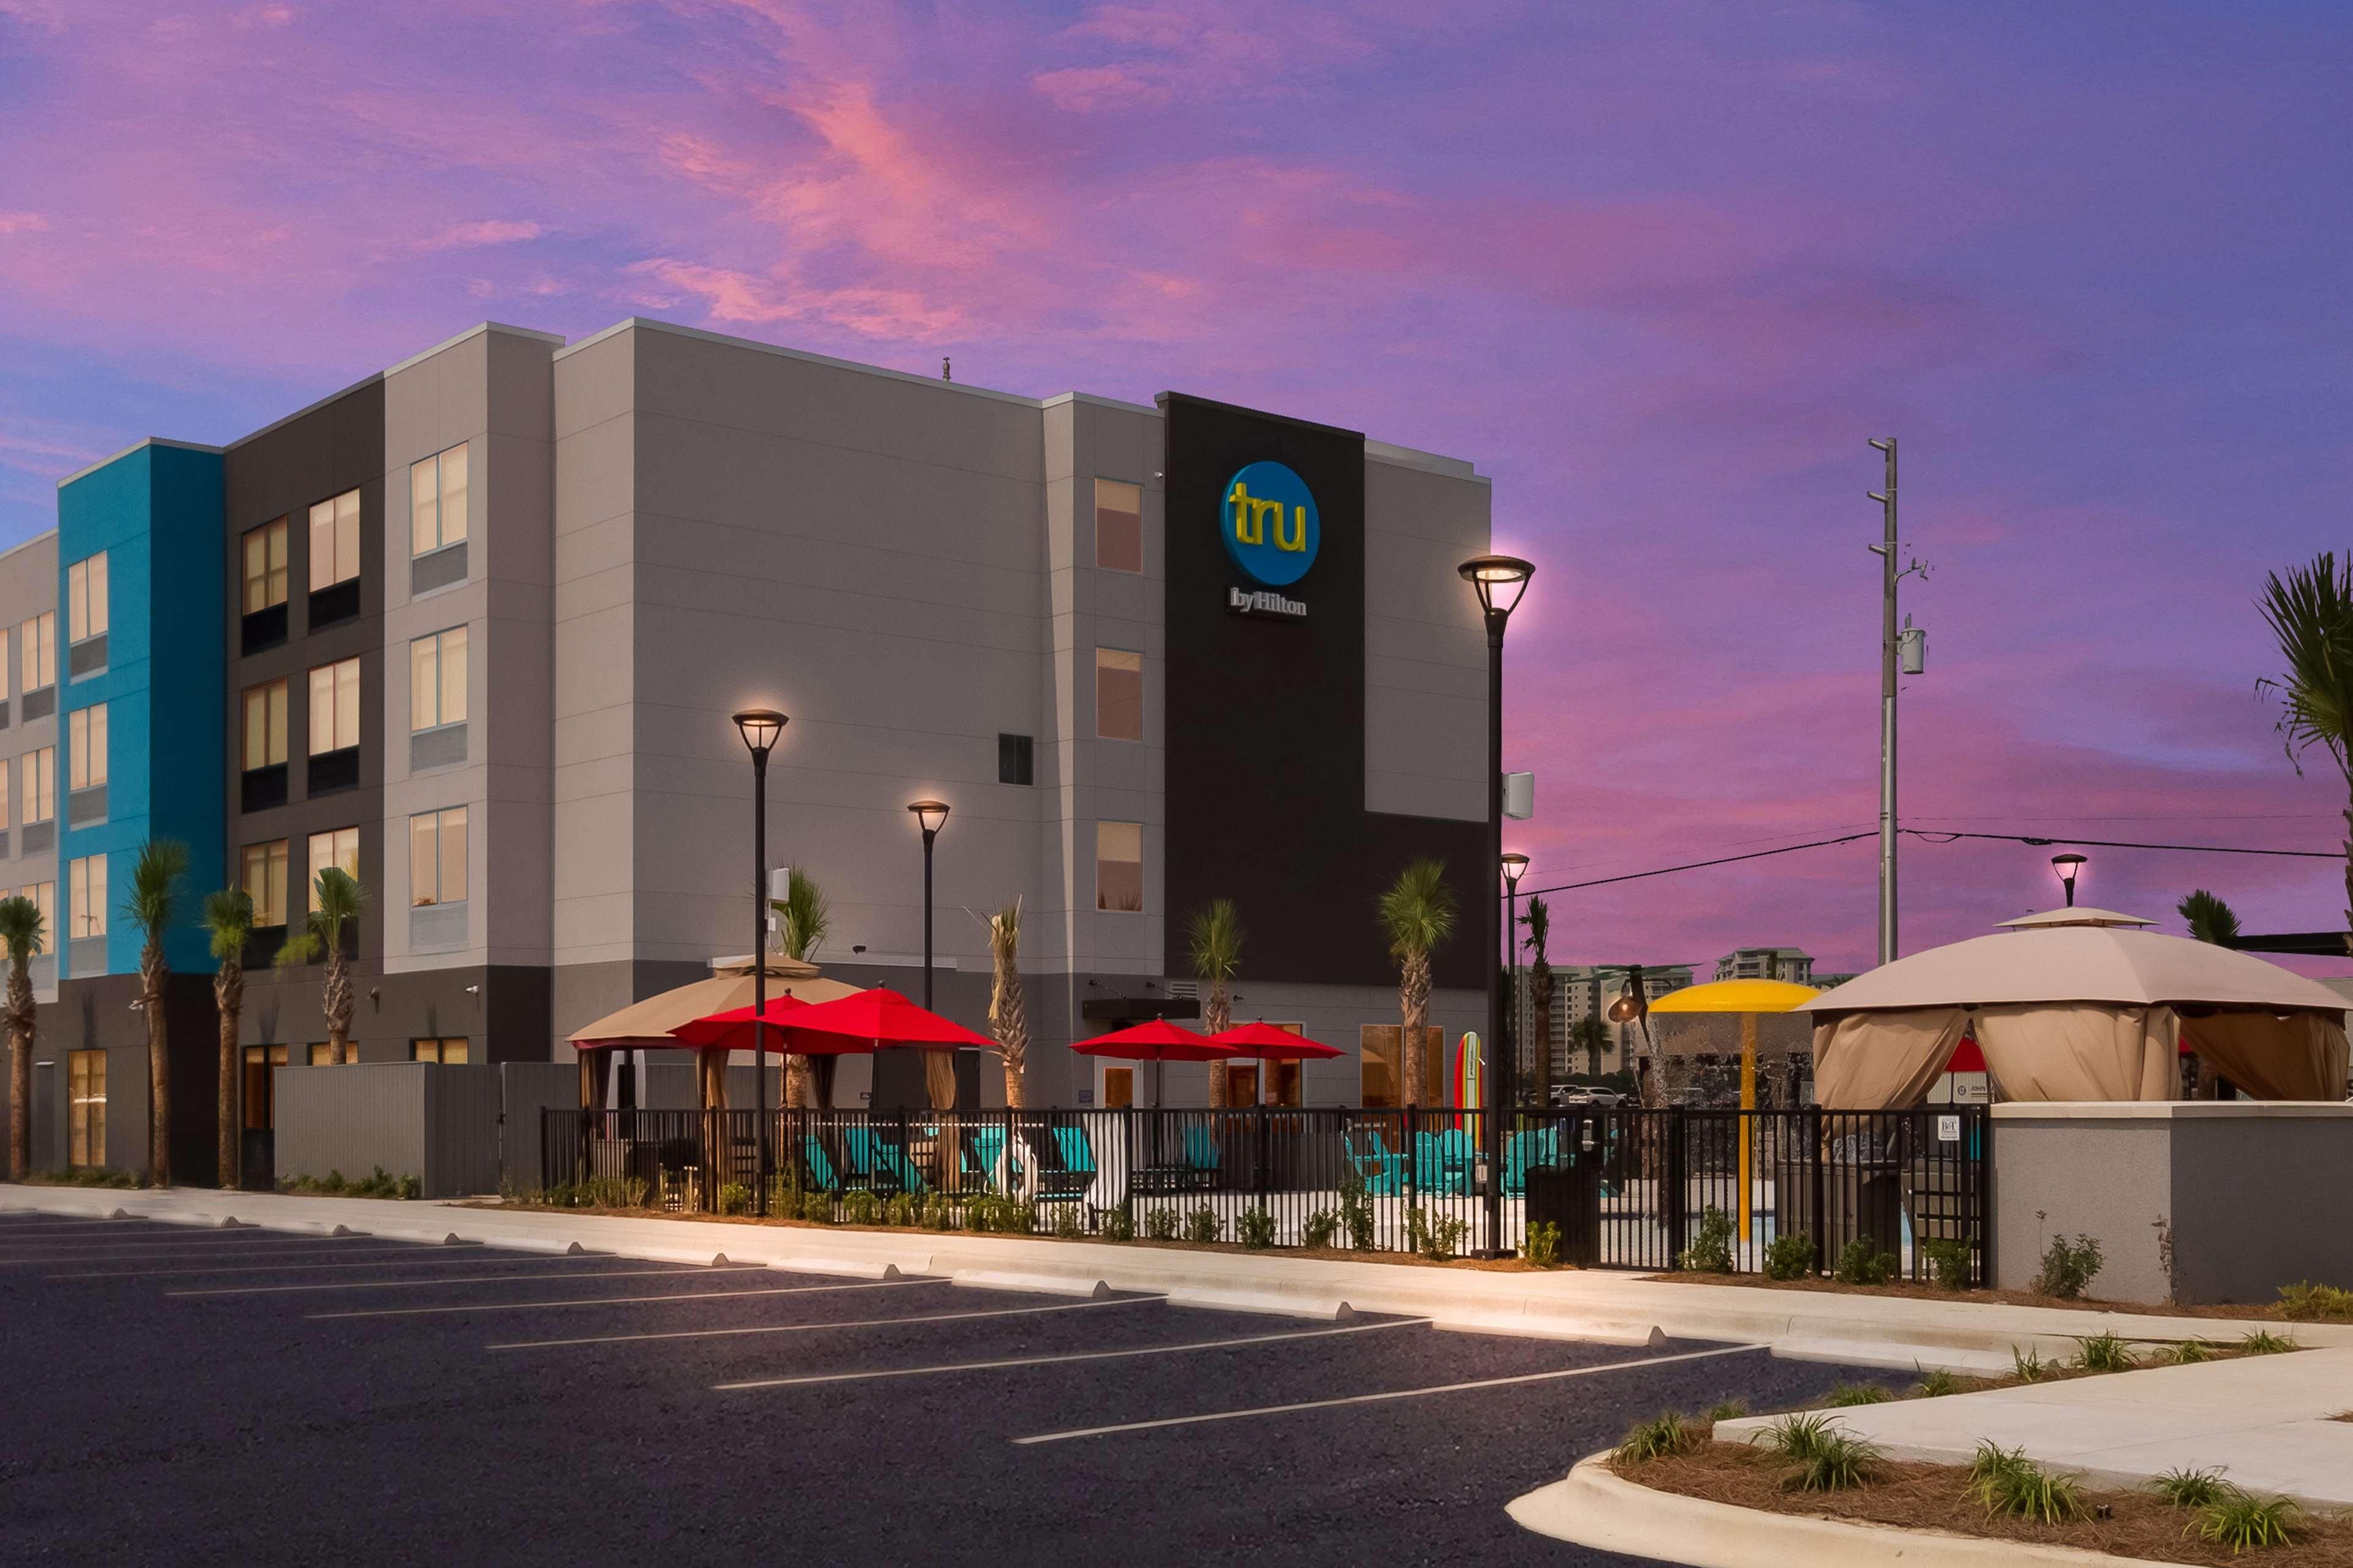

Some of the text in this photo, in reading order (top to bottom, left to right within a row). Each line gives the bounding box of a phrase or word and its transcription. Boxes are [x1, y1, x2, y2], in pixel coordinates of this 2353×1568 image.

[1229, 483, 1306, 551] tru
[1230, 587, 1307, 616] by Hilton
